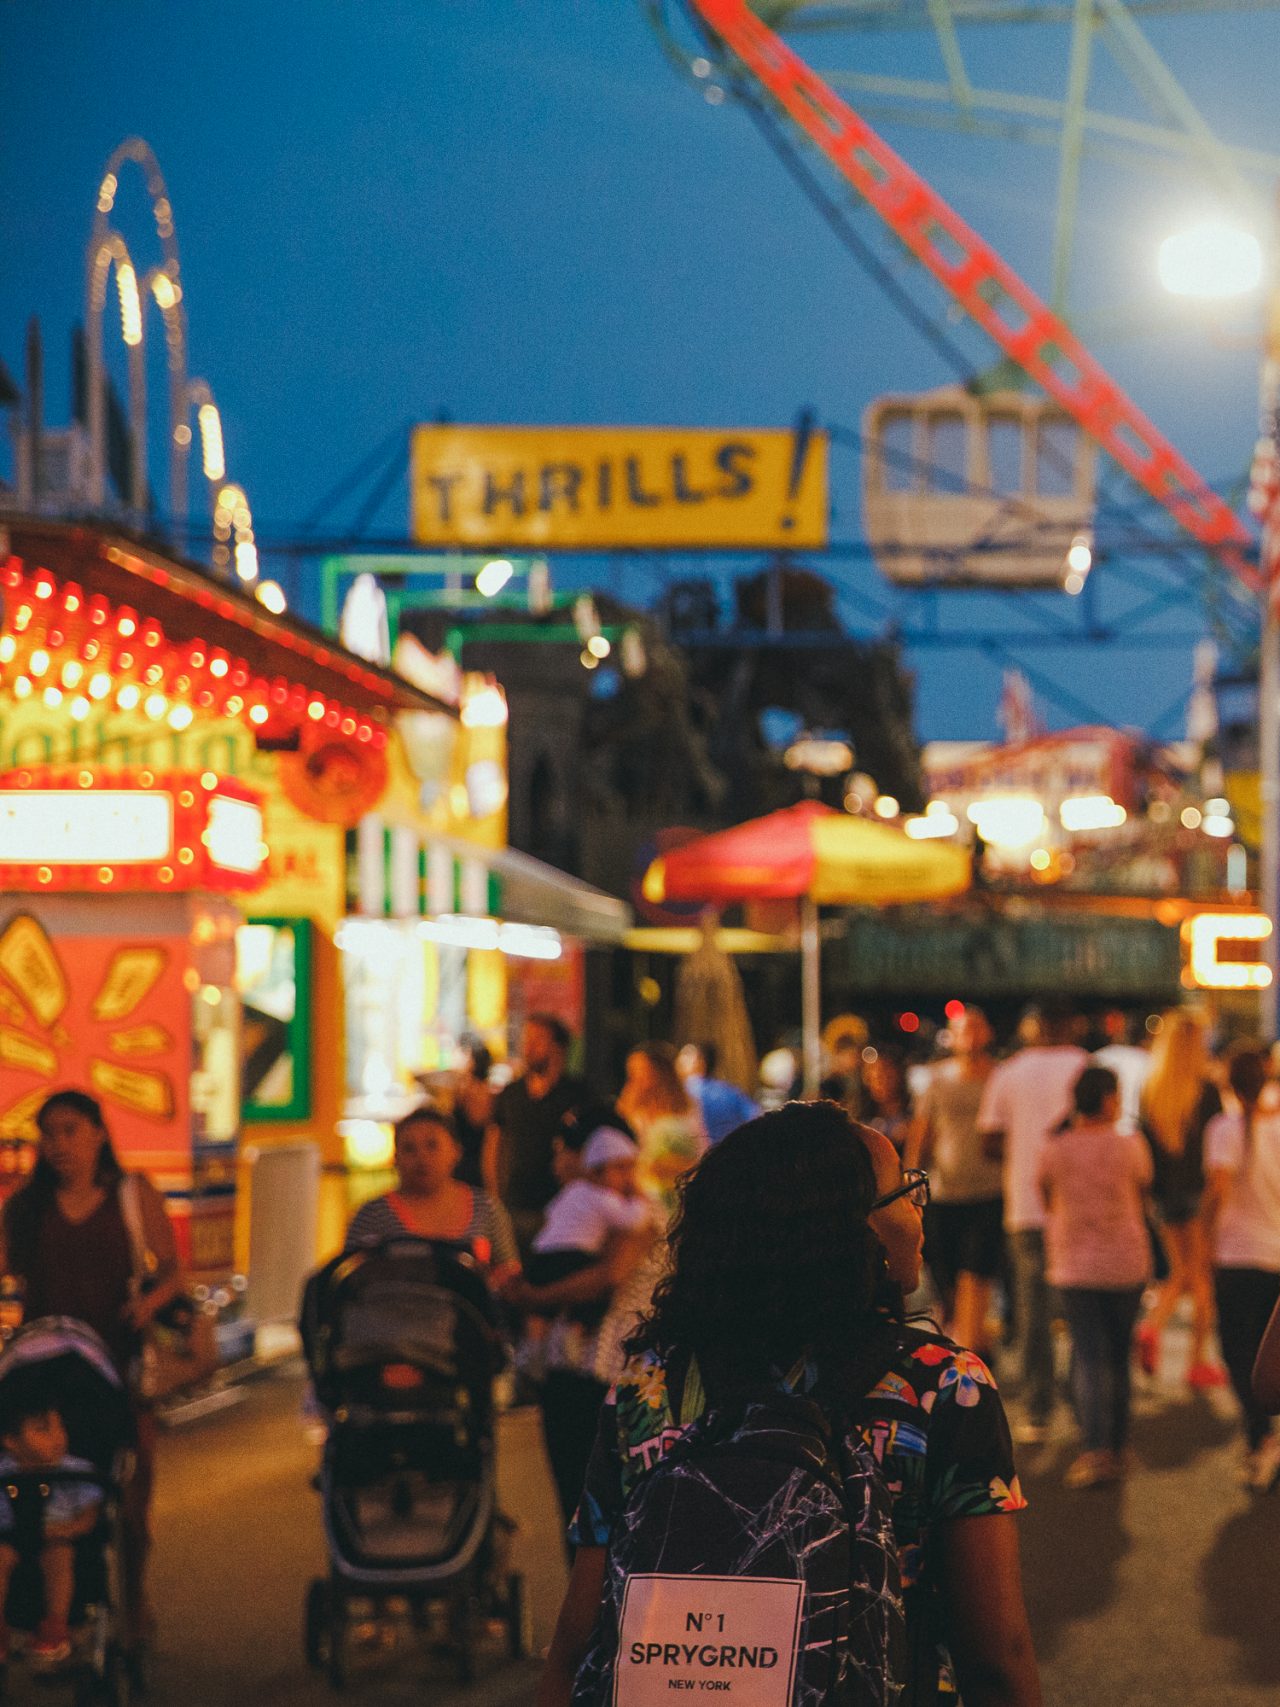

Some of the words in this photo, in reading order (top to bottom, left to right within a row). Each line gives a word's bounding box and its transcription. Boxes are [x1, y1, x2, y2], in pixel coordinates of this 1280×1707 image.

[630, 1642, 778, 1668] SPRYGRND
[668, 1679, 695, 1690] NEW
[699, 1680, 731, 1691] YORK
